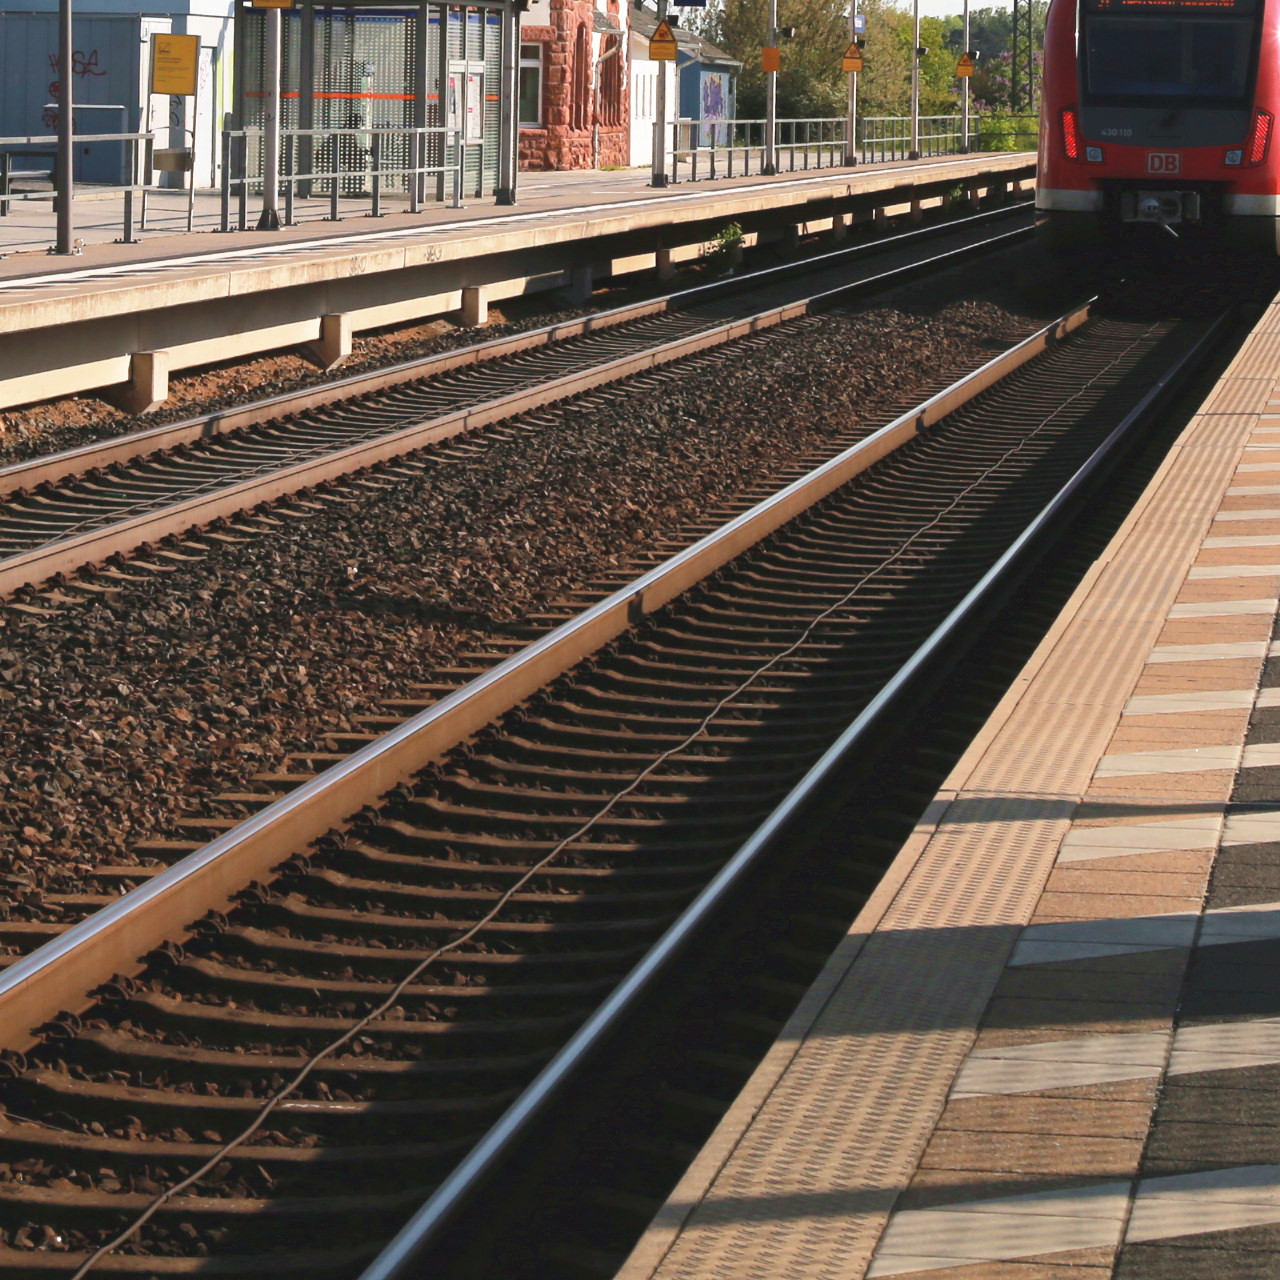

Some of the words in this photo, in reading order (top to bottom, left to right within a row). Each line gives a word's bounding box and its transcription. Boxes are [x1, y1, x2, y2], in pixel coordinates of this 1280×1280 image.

[1101, 128, 1118, 137] 430
[1119, 128, 1133, 137] 110
[1149, 154, 1179, 172] DB
